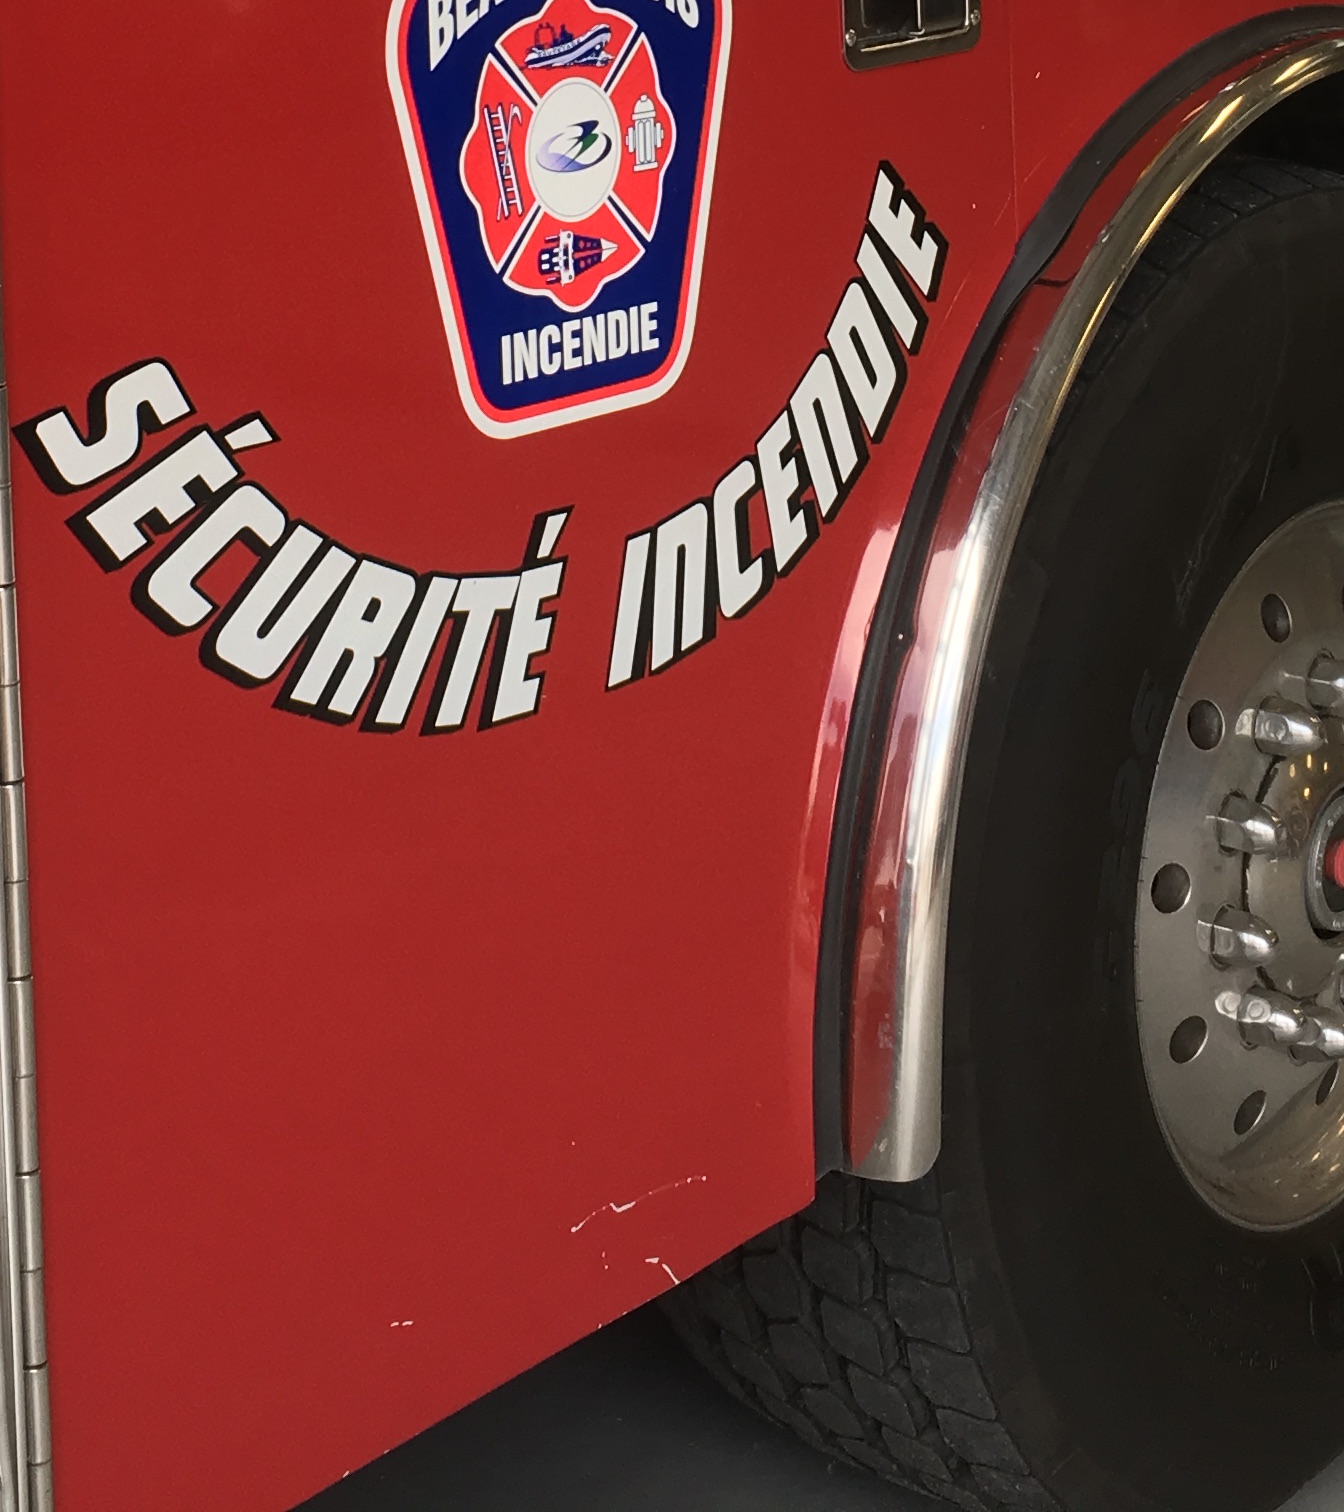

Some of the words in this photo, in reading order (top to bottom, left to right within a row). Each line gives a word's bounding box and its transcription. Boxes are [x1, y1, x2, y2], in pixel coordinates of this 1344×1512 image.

[16, 357, 573, 734] SÉCURITÉ
[605, 160, 948, 690] INCENDIE
[500, 301, 660, 386] INCENDIE
